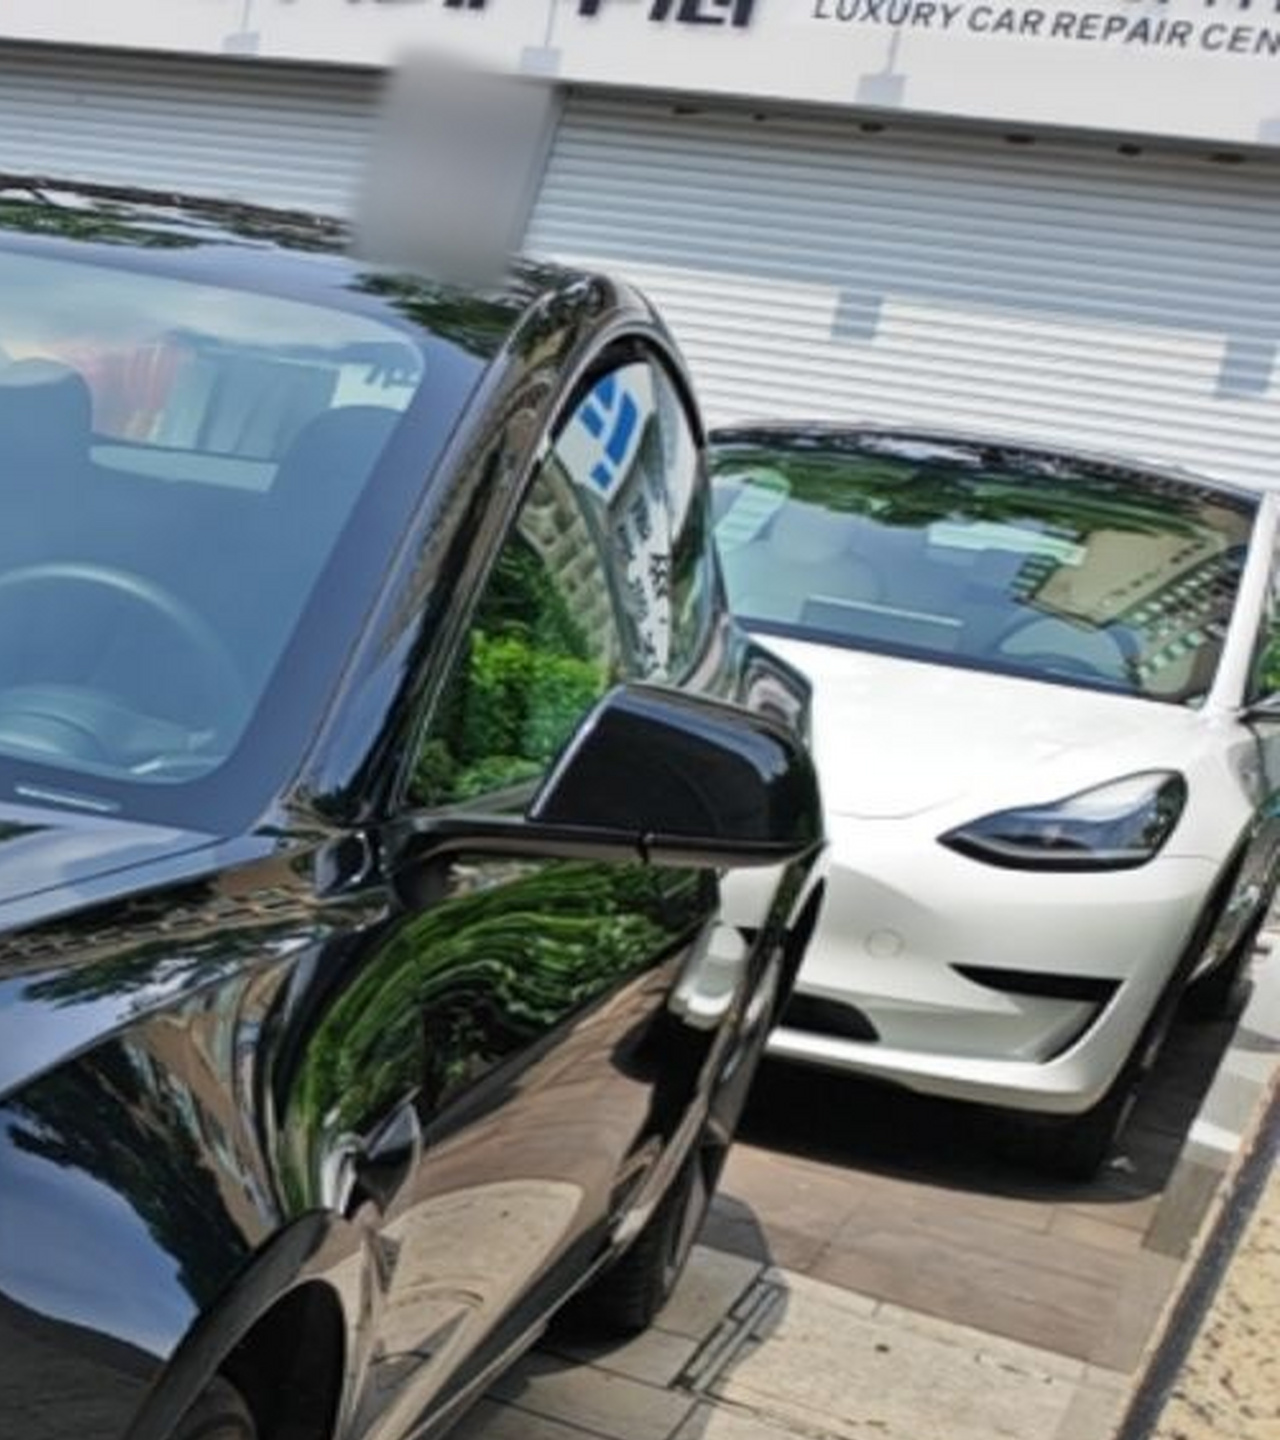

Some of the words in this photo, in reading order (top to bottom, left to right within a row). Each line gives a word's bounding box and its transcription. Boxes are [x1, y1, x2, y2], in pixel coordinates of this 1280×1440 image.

[812, 0, 963, 29] LUXURY
[968, 6, 1046, 36] CAR
[1050, 12, 1194, 48] REPAIR
